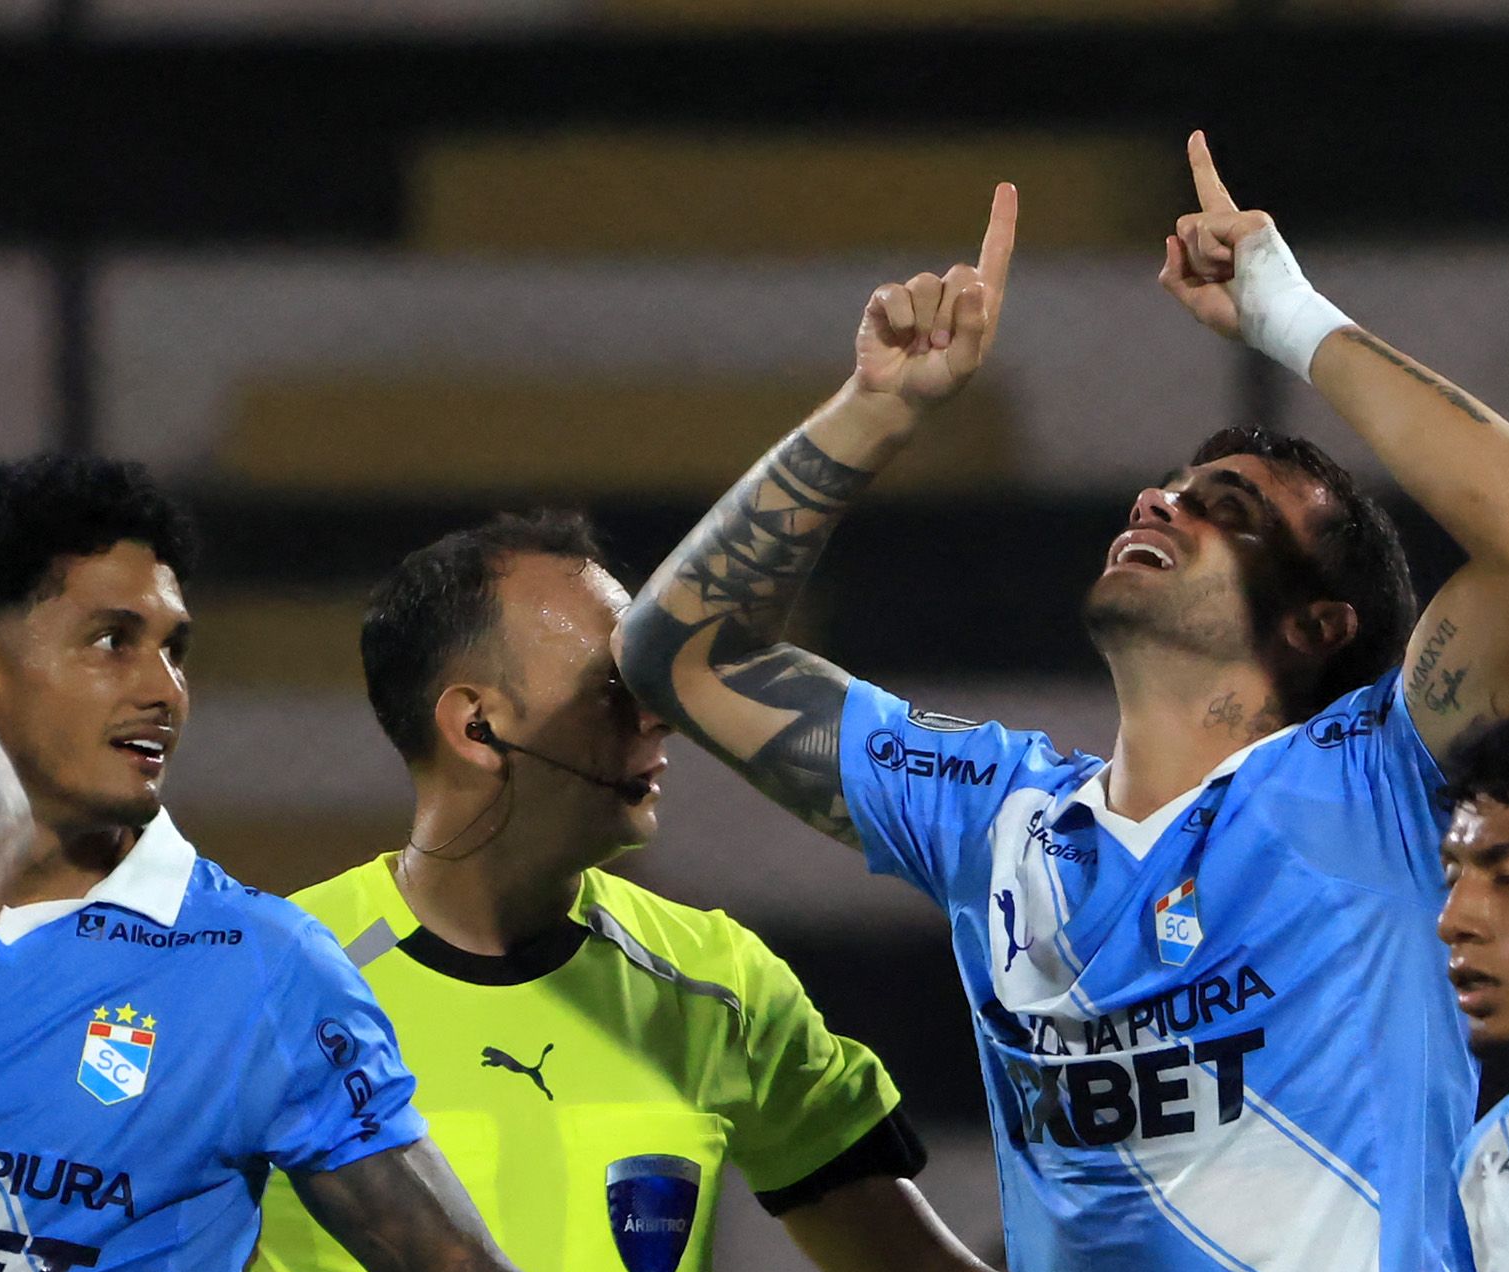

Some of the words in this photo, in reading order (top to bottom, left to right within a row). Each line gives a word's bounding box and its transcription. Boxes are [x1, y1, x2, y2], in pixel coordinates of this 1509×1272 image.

[904, 748, 997, 785] GWM
[108, 922, 243, 948] Alkofarma
[1165, 916, 1189, 941] SC
[1128, 965, 1276, 1046] PIURA
[96, 1049, 132, 1084] SC
[1007, 1027, 1265, 1148] XBET
[624, 1213, 686, 1233] ÁRBITRO
